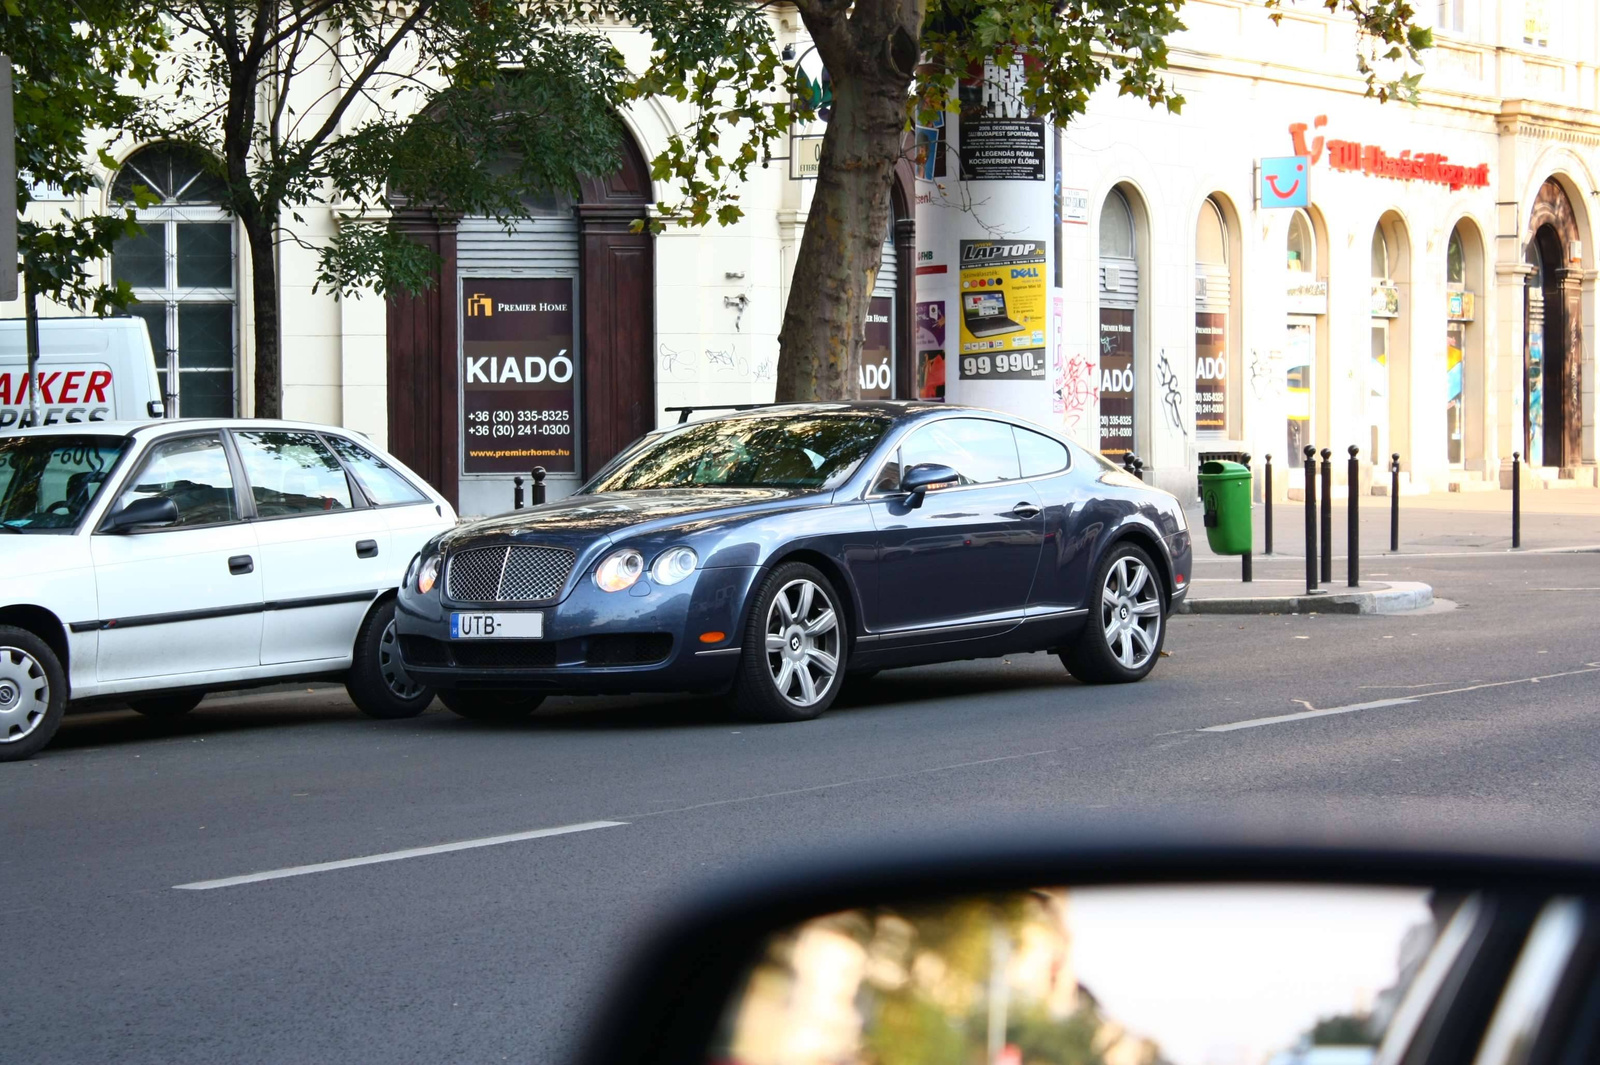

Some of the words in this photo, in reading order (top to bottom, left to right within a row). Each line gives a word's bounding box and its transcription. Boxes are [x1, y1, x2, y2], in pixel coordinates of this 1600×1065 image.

[983, 64, 1025, 82] BEN
[981, 149, 1015, 157] LEGENDÁS
[1015, 149, 1034, 157] RÓMAI
[1017, 157, 1040, 165] ÉLŐBEN
[963, 243, 1036, 261] LAPTOP
[1011, 267, 1039, 279] DELL
[466, 349, 573, 383] KIADÓ
[963, 356, 992, 376] 99
[468, 411, 489, 422] +36
[492, 411, 515, 424] (30)
[517, 410, 569, 422] 335-8325
[468, 425, 489, 436] +36
[492, 425, 515, 438] (30)
[517, 424, 570, 436] 241-0300
[1109, 427, 1132, 437] 241-0300
[469, 448, 570, 458] www.premierhome.hu
